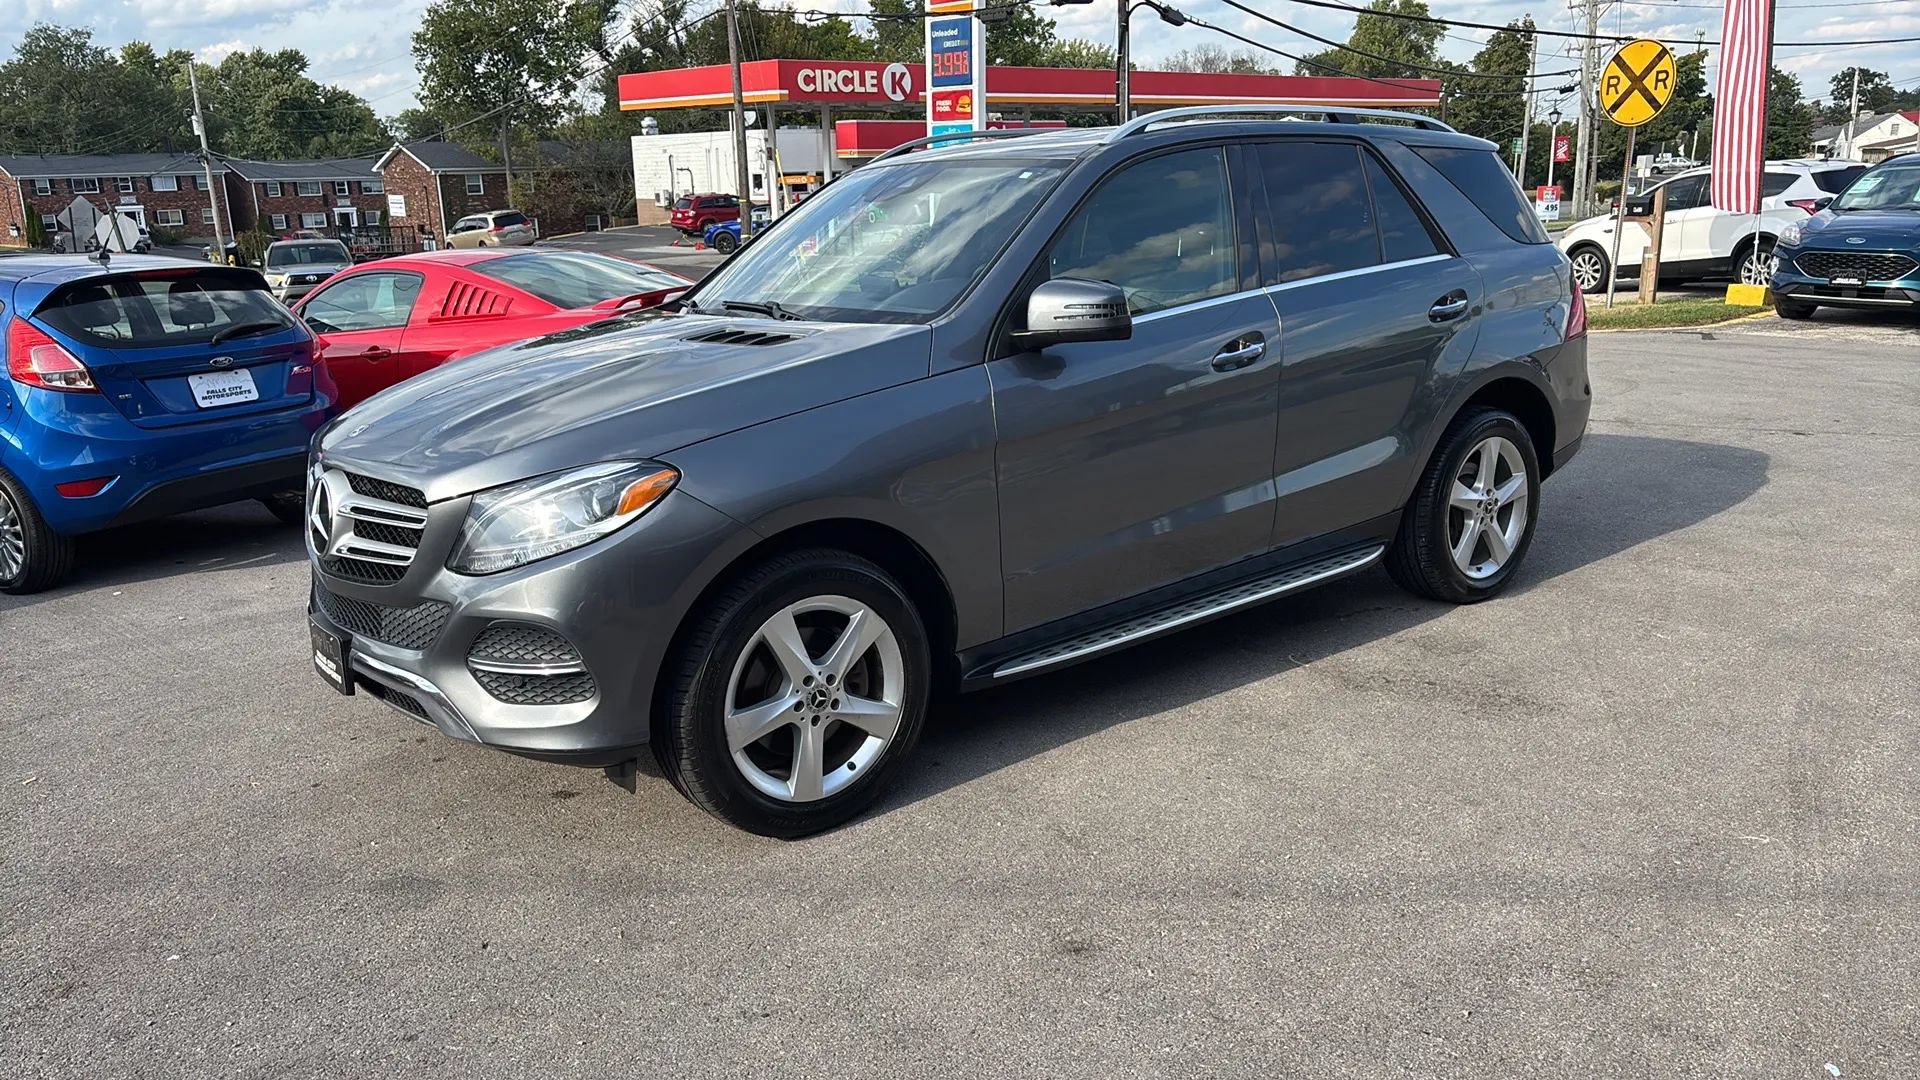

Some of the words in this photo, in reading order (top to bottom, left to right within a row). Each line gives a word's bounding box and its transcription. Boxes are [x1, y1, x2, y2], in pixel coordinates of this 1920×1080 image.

[931, 28, 958, 38] Unleaded
[797, 68, 878, 93] CIRCLE
[889, 70, 911, 100] K
[1605, 75, 1620, 96] R
[1653, 69, 1669, 91] R
[201, 389, 252, 401] MOTORSPORTS
[206, 387, 227, 395] FALLS
